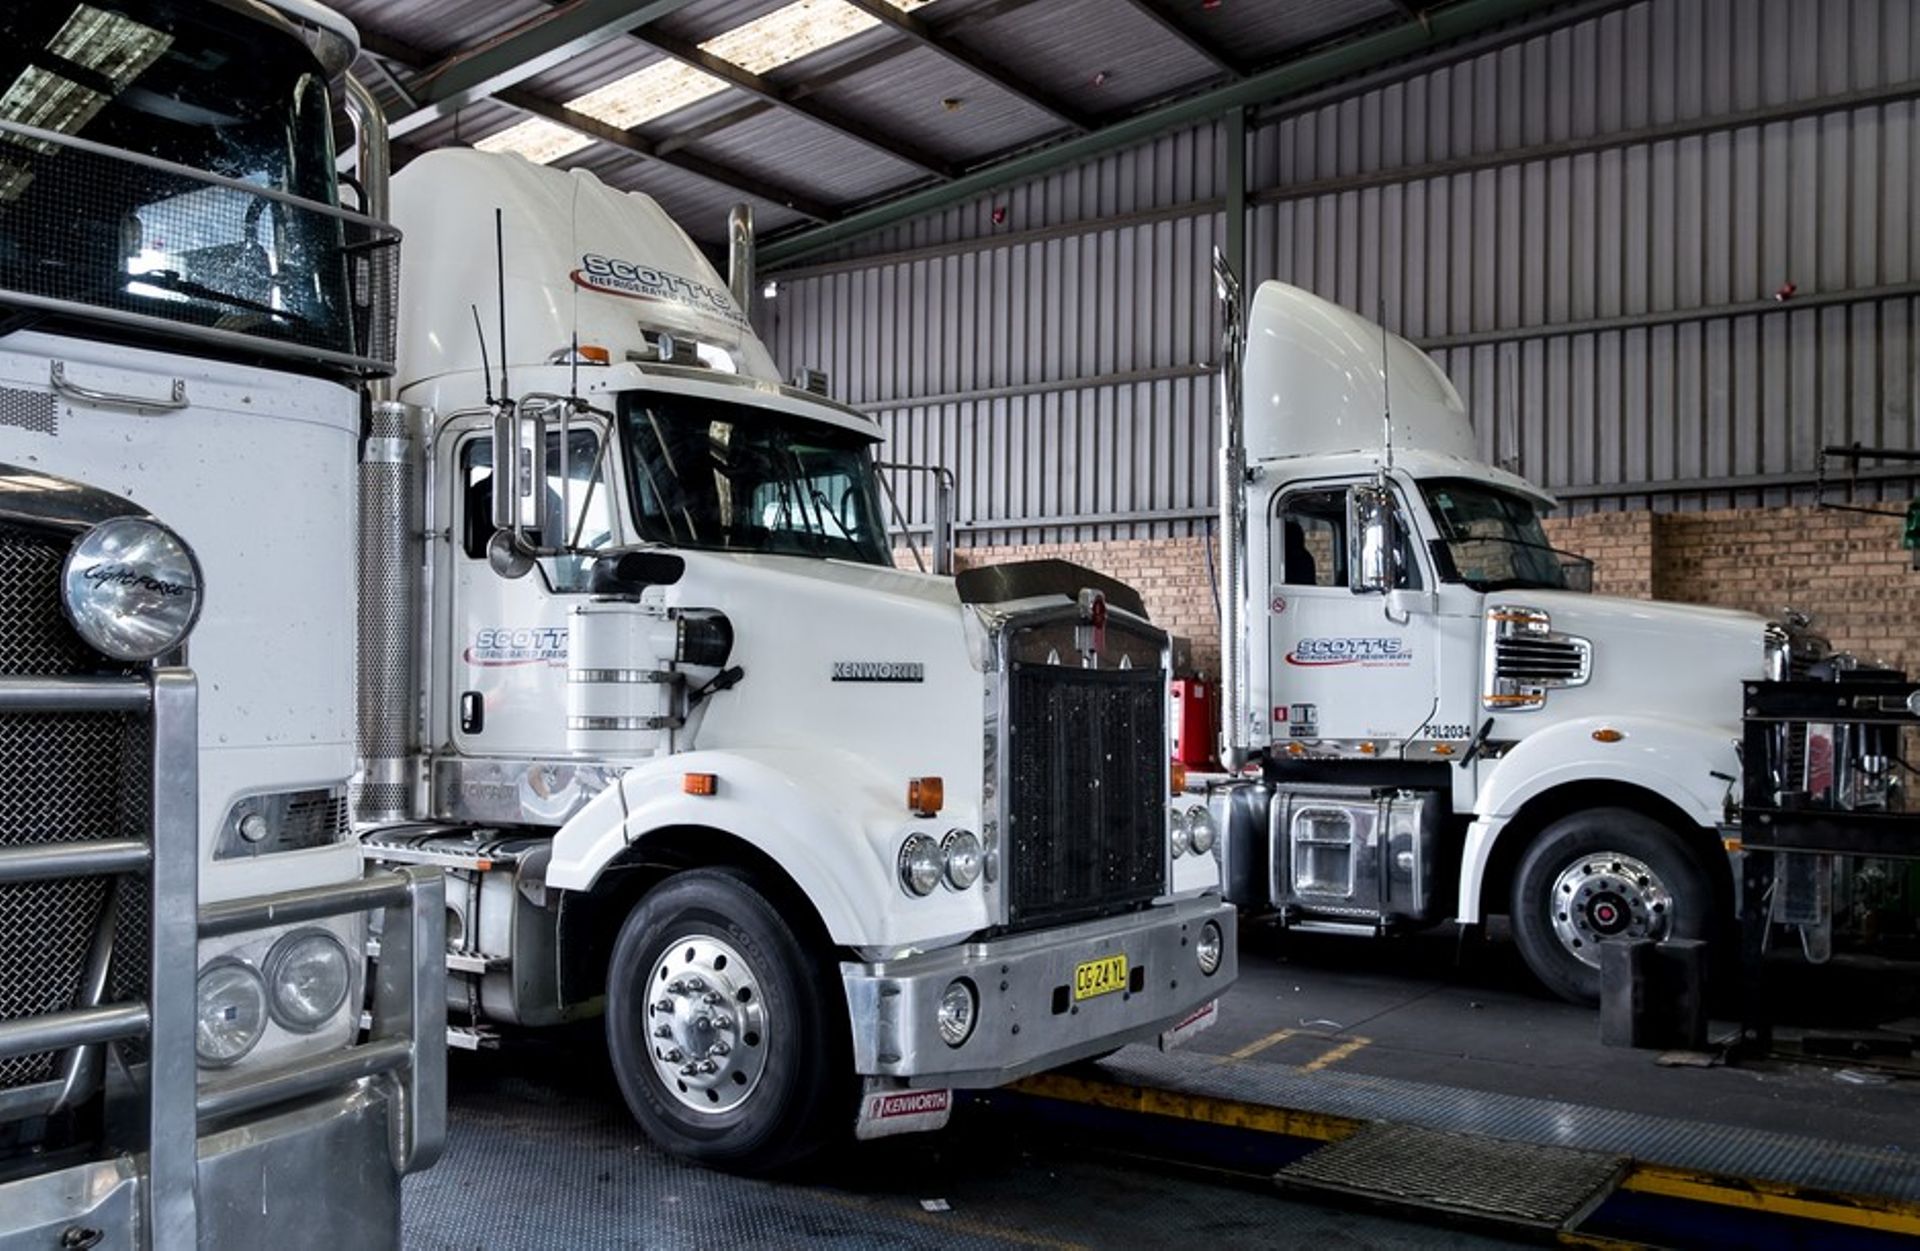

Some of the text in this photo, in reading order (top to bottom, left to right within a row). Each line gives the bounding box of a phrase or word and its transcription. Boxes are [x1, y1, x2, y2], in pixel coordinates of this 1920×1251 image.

[583, 254, 730, 310] SCOTT'S
[1296, 638, 1402, 654] SCOTT'S
[832, 661, 924, 681] KENWORTH
[1423, 724, 1471, 739] P3L2034
[882, 1091, 947, 1115] KENWORTH
